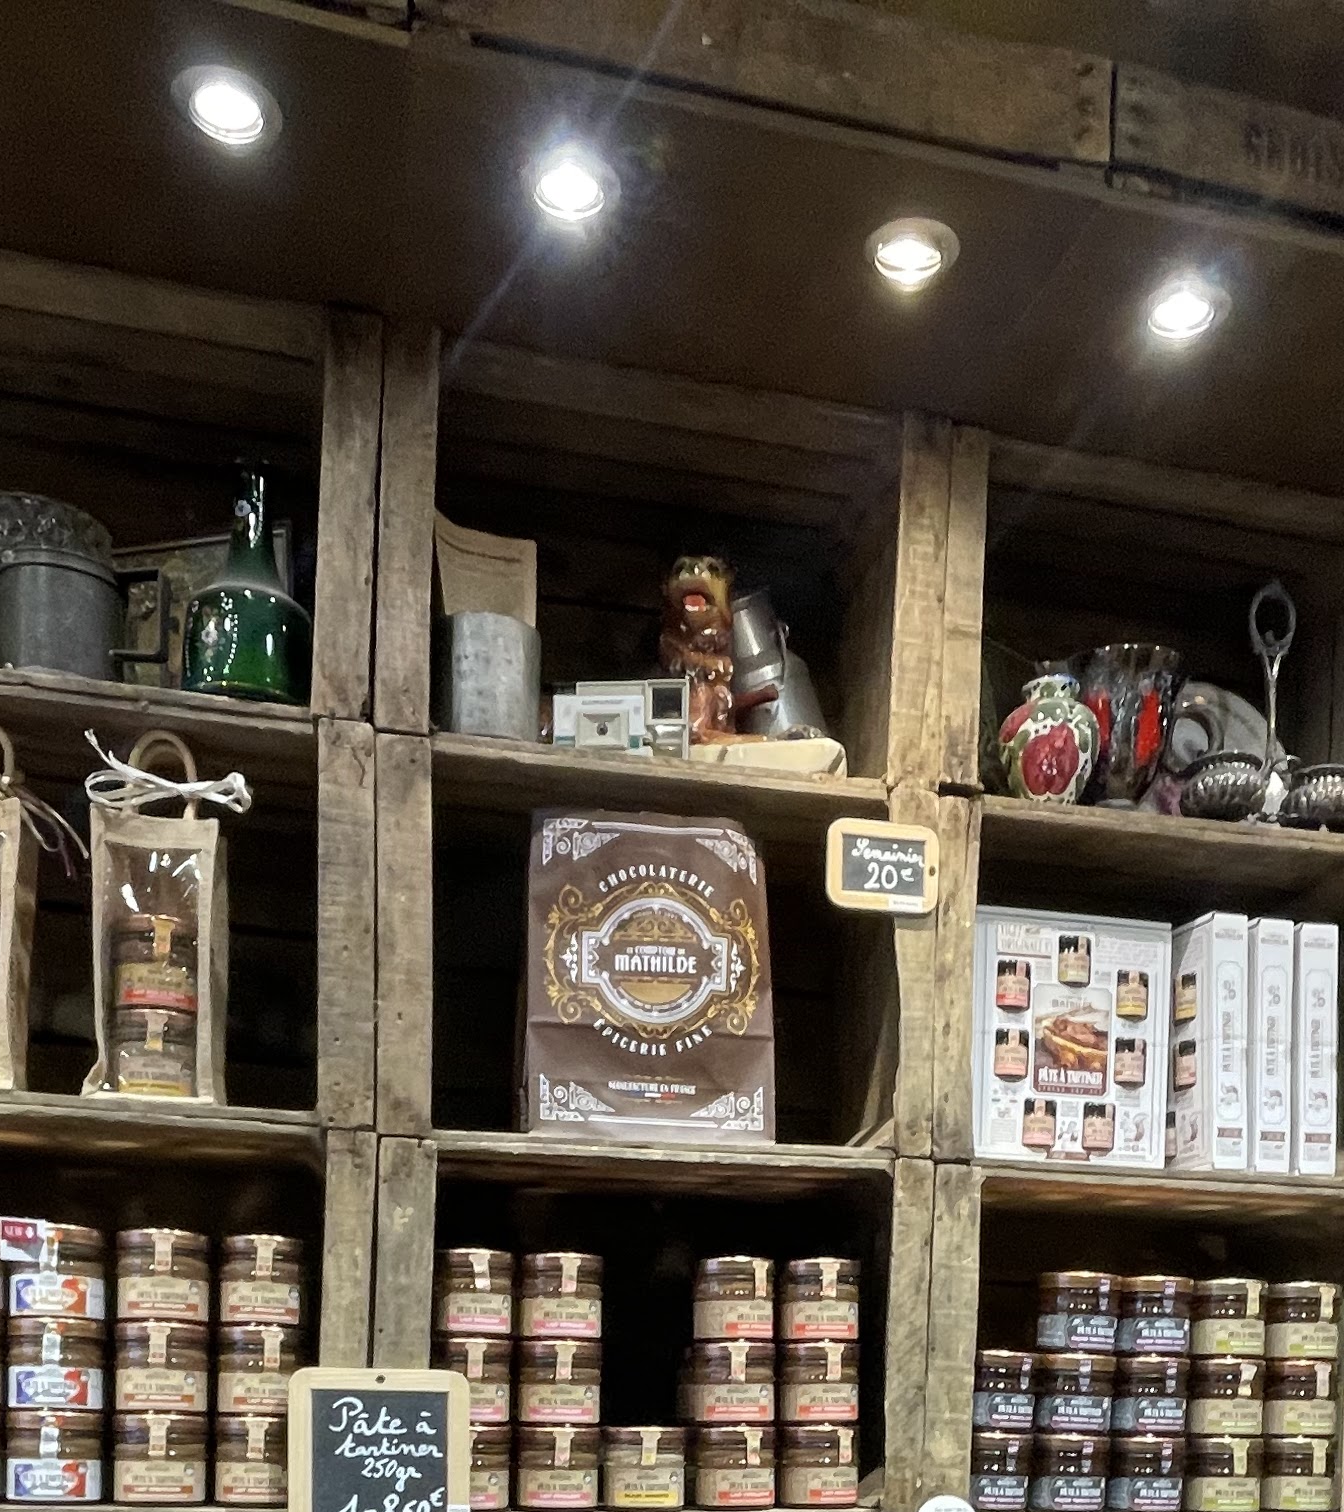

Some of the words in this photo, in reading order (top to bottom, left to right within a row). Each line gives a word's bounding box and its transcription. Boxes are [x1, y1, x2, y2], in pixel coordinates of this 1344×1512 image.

[598, 864, 715, 909] CHOCOLATERIE
[863, 861, 915, 890] 20€
[614, 954, 698, 975] MATHILDE
[675, 1025, 714, 1053] FINE
[334, 1432, 444, 1459] tartiner
